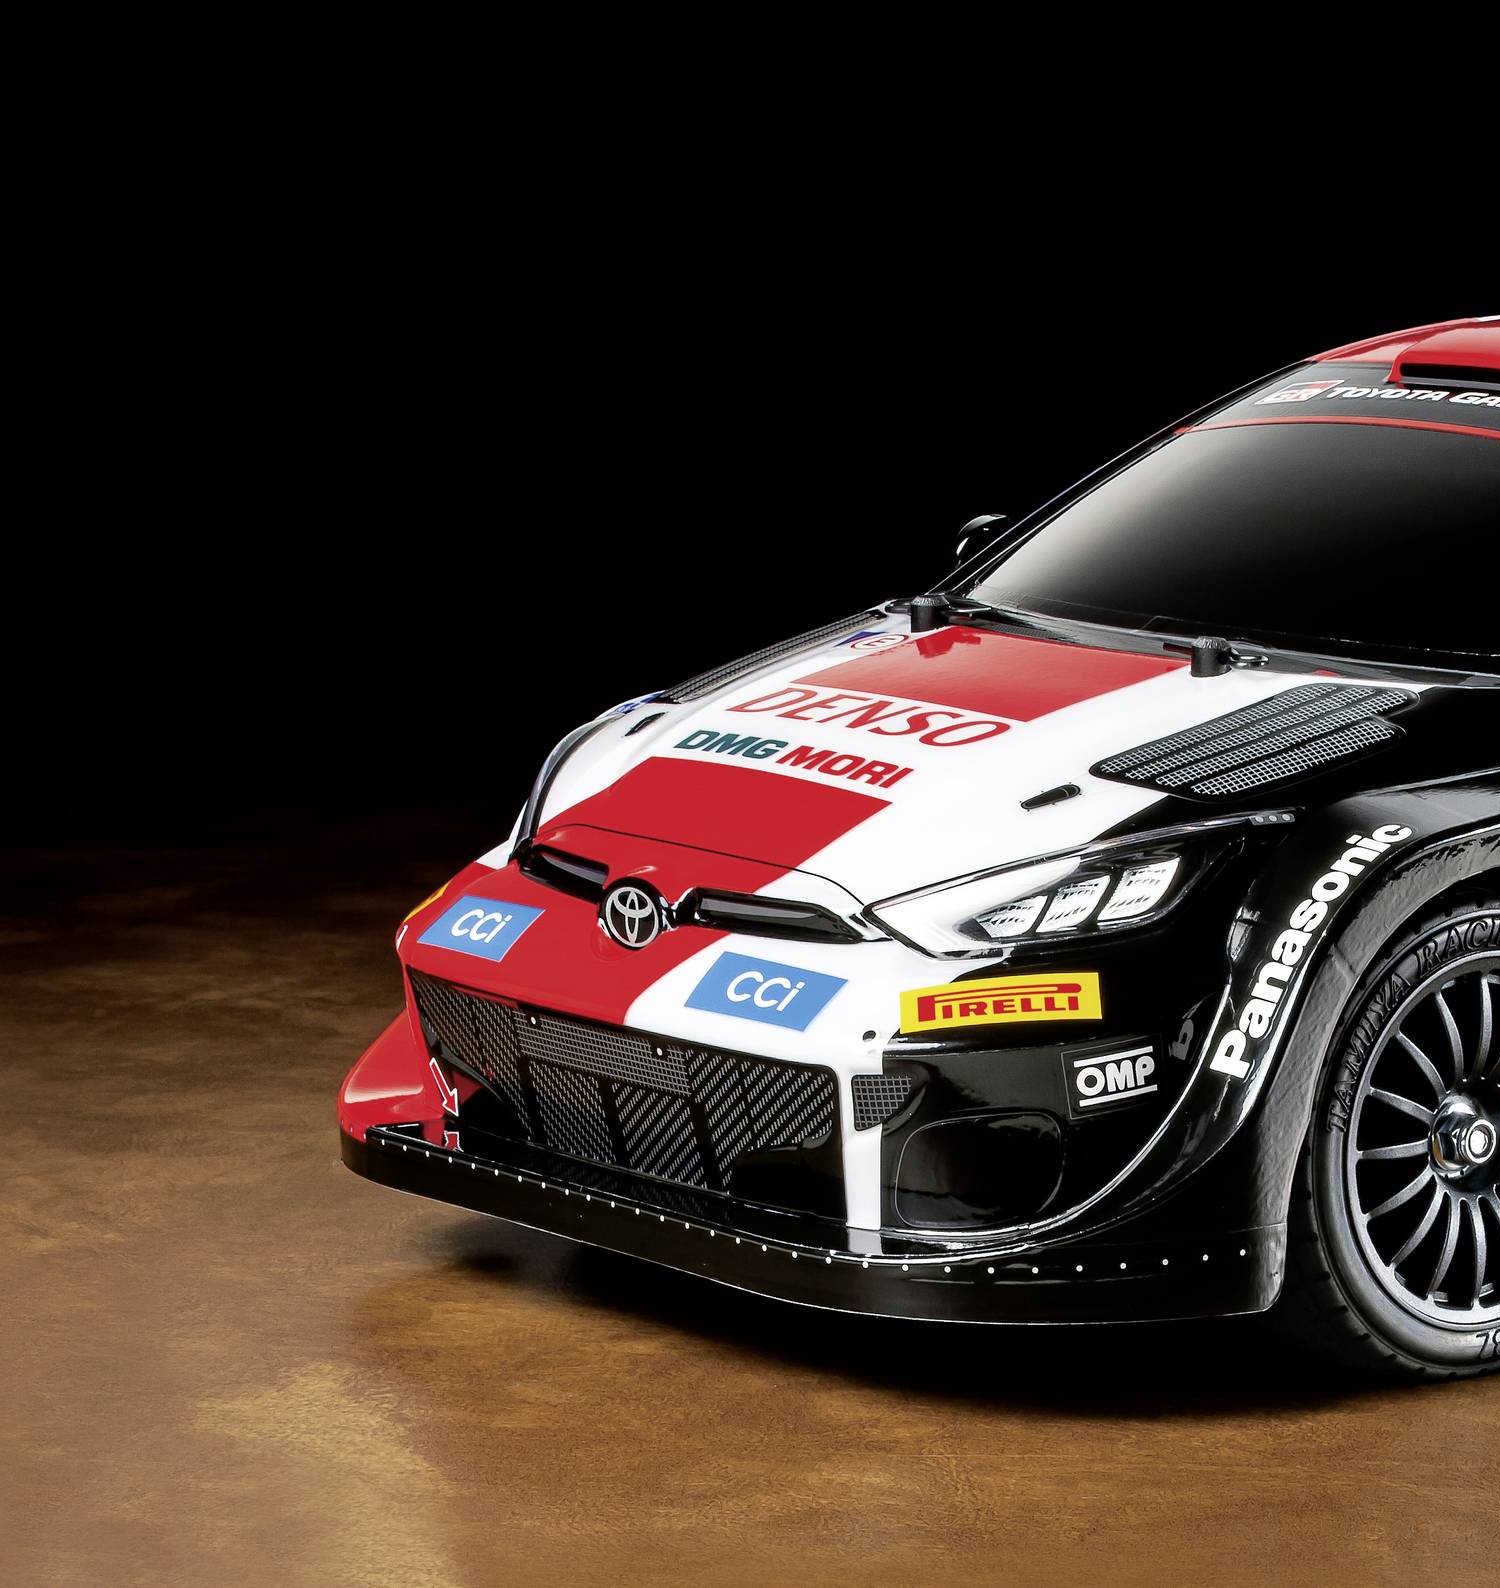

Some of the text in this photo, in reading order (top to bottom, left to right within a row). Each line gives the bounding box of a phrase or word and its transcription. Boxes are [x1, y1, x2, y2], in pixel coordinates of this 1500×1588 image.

[1327, 387, 1450, 401] TOYOTA
[725, 687, 1011, 747] DENSO
[674, 730, 914, 789] DMG MORI
[1209, 822, 1413, 1079] Panasonic
[917, 983, 1082, 1021] PIRELLI
[1076, 1055, 1156, 1097] OMP
[1326, 971, 1413, 1133] TAMIYA
